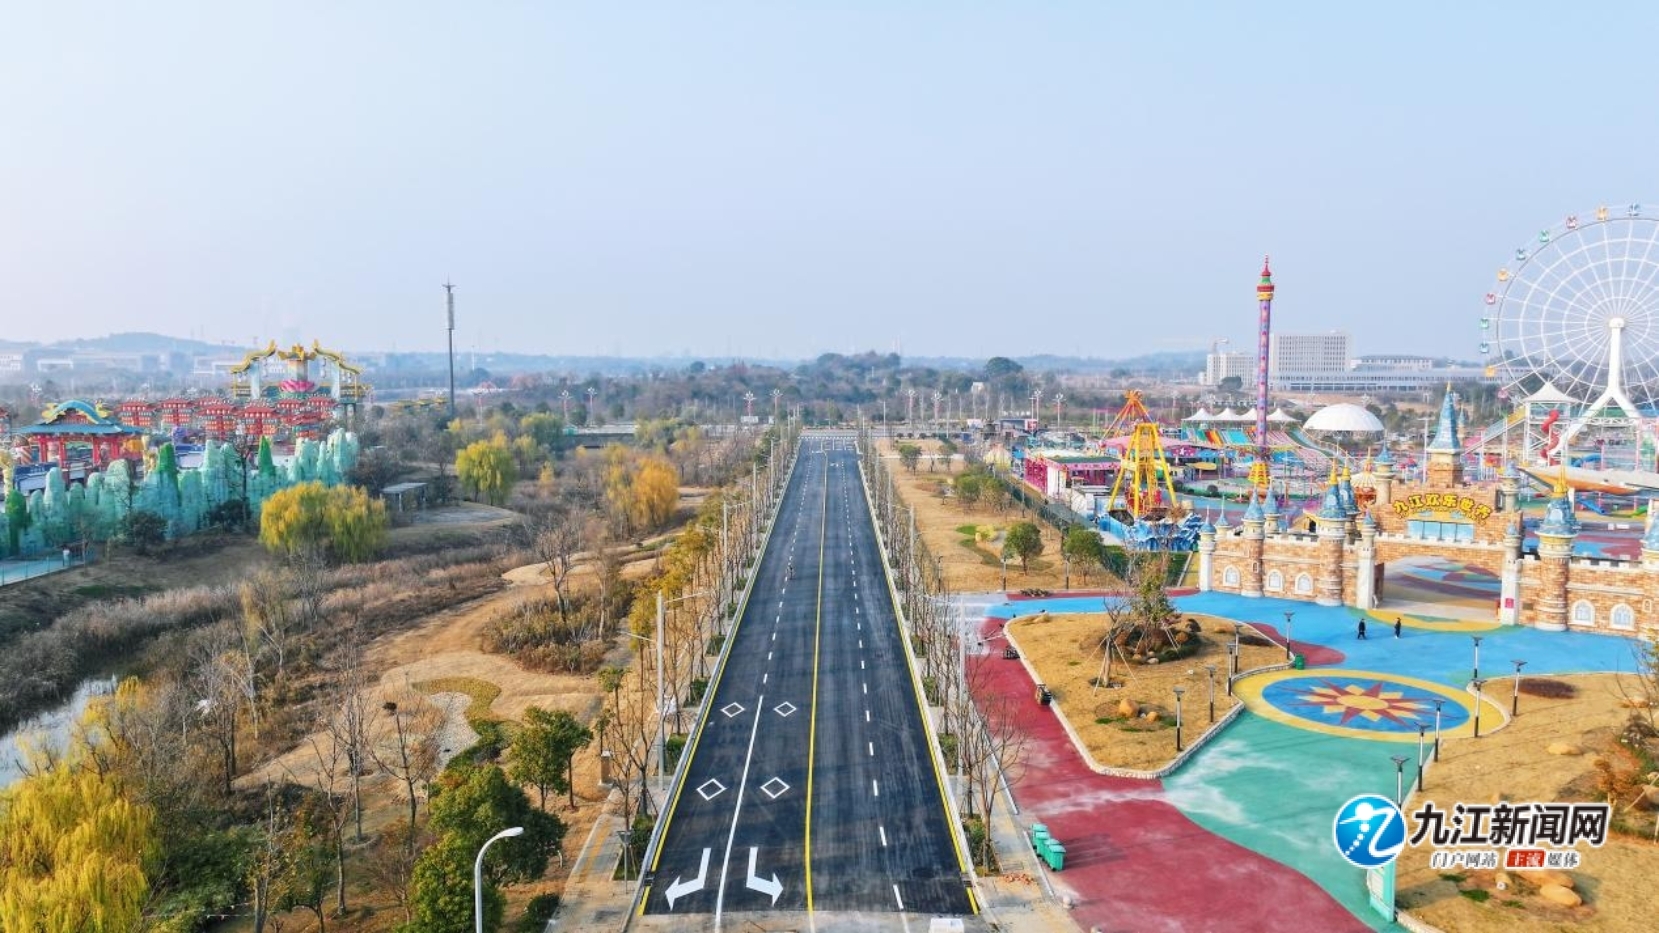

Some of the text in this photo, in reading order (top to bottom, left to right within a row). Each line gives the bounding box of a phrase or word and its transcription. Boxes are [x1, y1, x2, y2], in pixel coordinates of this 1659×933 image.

[1393, 493, 1492, 519] 九江欢乐世界
